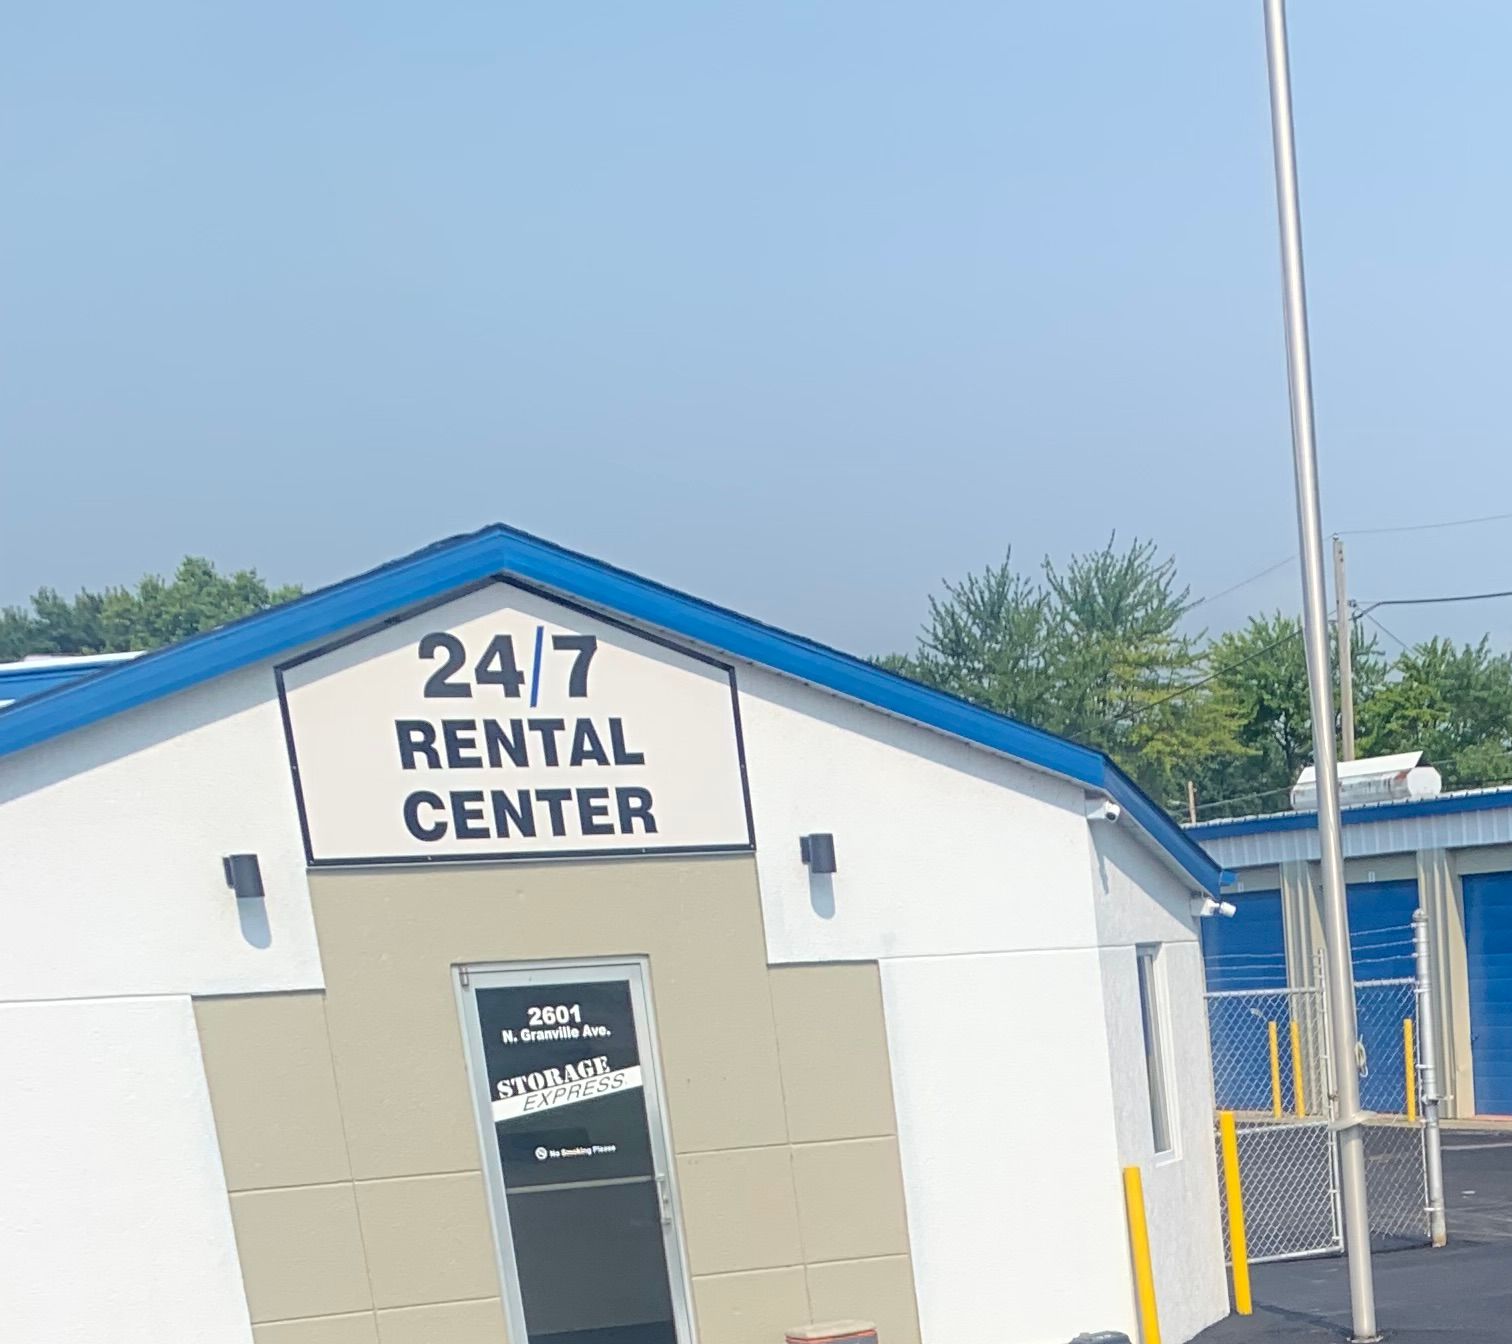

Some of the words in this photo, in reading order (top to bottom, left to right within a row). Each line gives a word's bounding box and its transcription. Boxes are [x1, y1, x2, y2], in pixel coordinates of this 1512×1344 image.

[417, 625, 598, 708] 24/7
[394, 717, 645, 770] RENTAL
[403, 786, 659, 842] CENTER
[502, 1029, 518, 1044] N.
[520, 1025, 580, 1042] Granville
[583, 1023, 612, 1038] Ave.
[527, 1004, 582, 1026] 2601
[496, 1055, 611, 1099] STORAGE
[523, 1072, 625, 1112] EXPRESS
[549, 1149, 560, 1158] No
[561, 1147, 592, 1158] Smoking
[592, 1144, 616, 1154] Please
